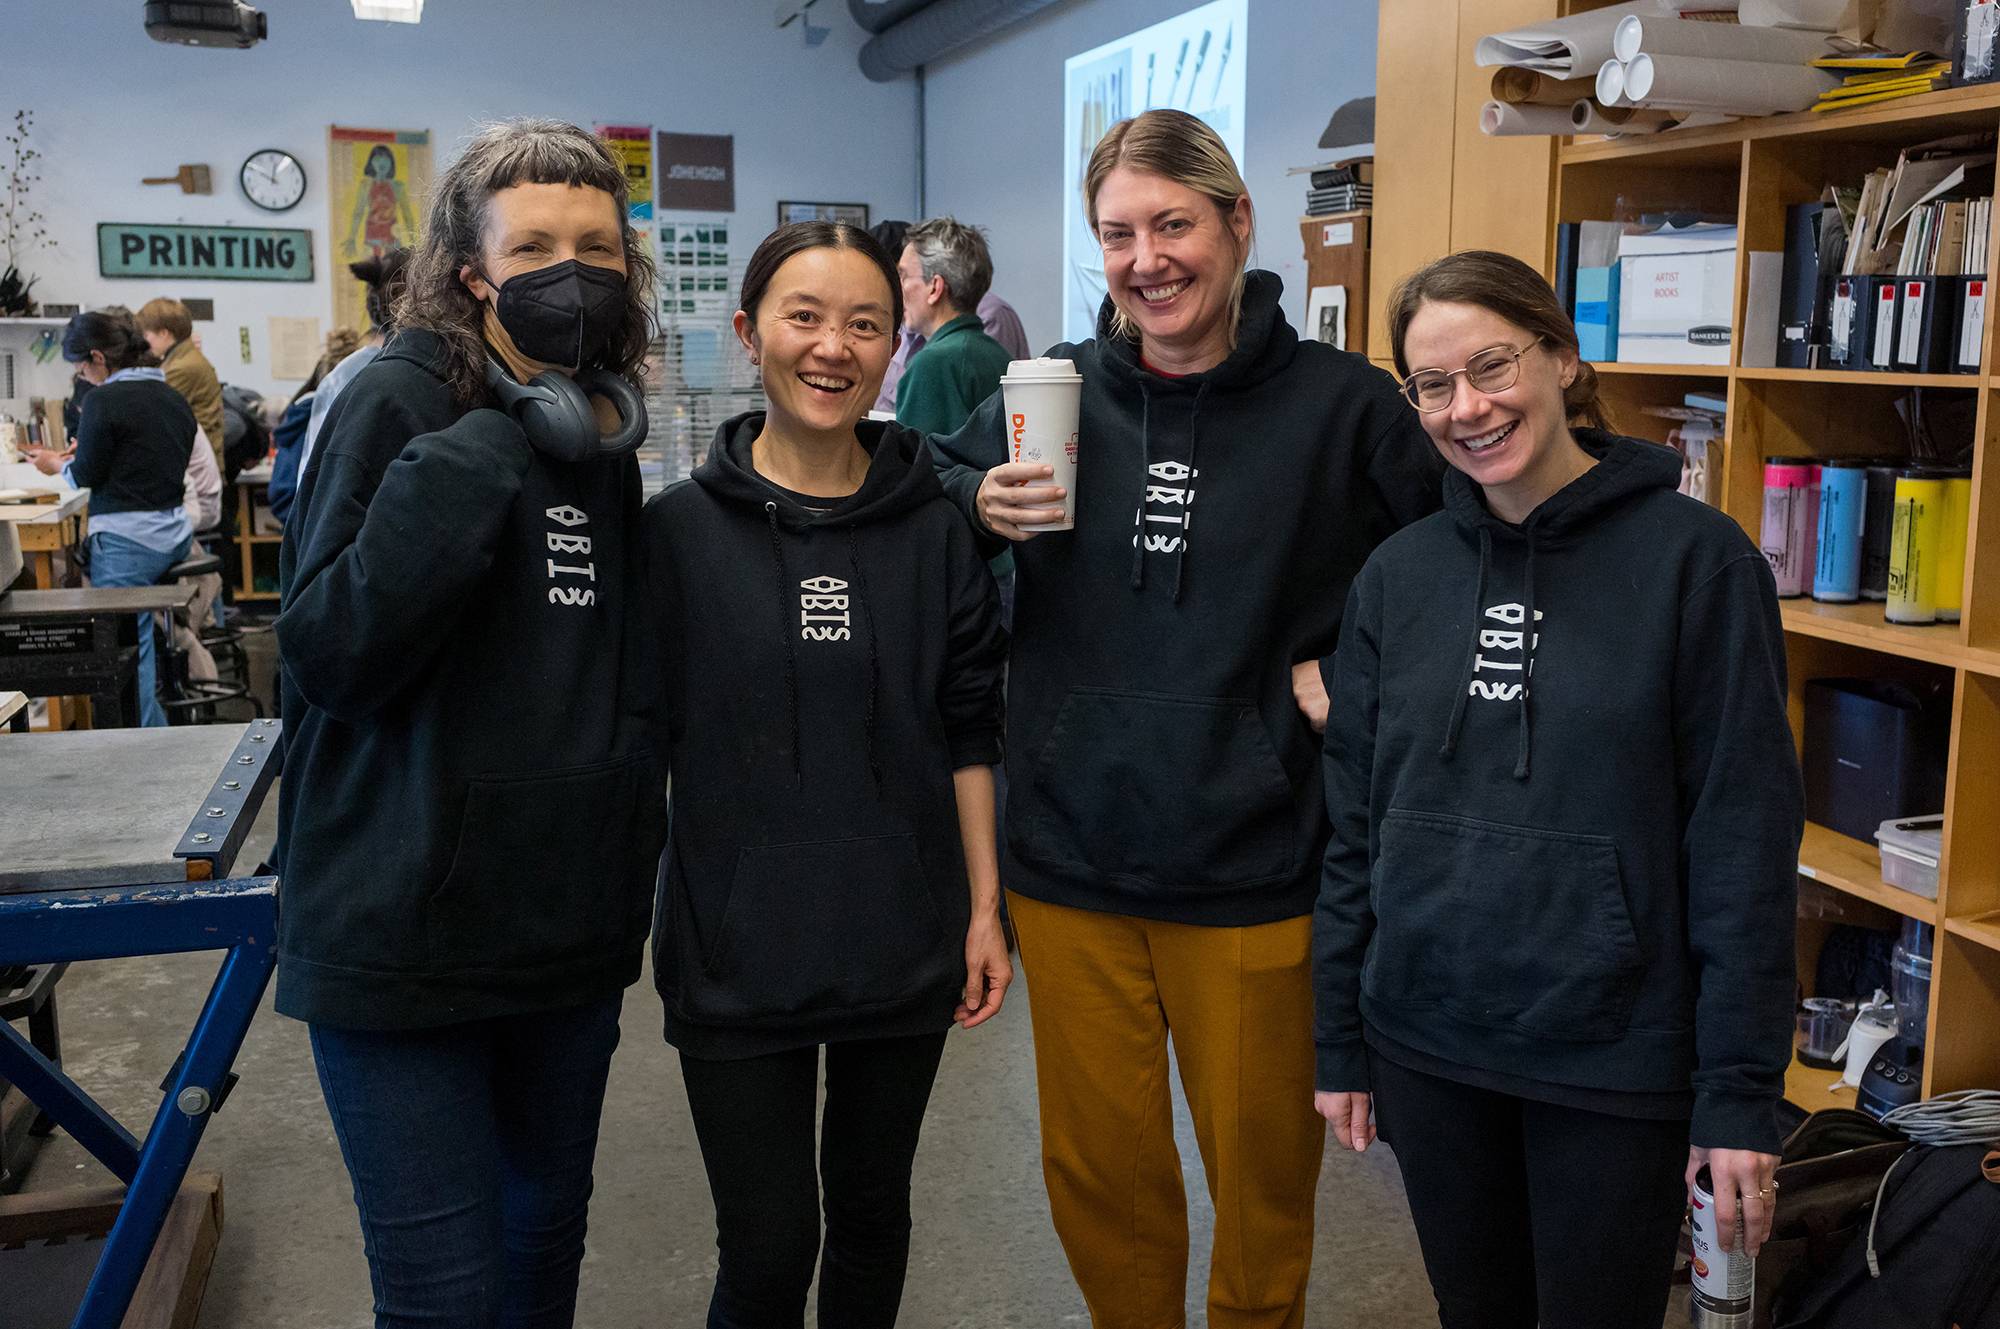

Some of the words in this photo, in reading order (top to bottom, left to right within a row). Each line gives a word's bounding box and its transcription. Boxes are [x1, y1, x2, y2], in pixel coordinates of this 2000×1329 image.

[120, 233, 295, 269] PRINTING
[1655, 271, 1680, 282] ARTIST
[1654, 287, 1680, 298] BOOKS
[1690, 332, 1720, 340] BANKERS
